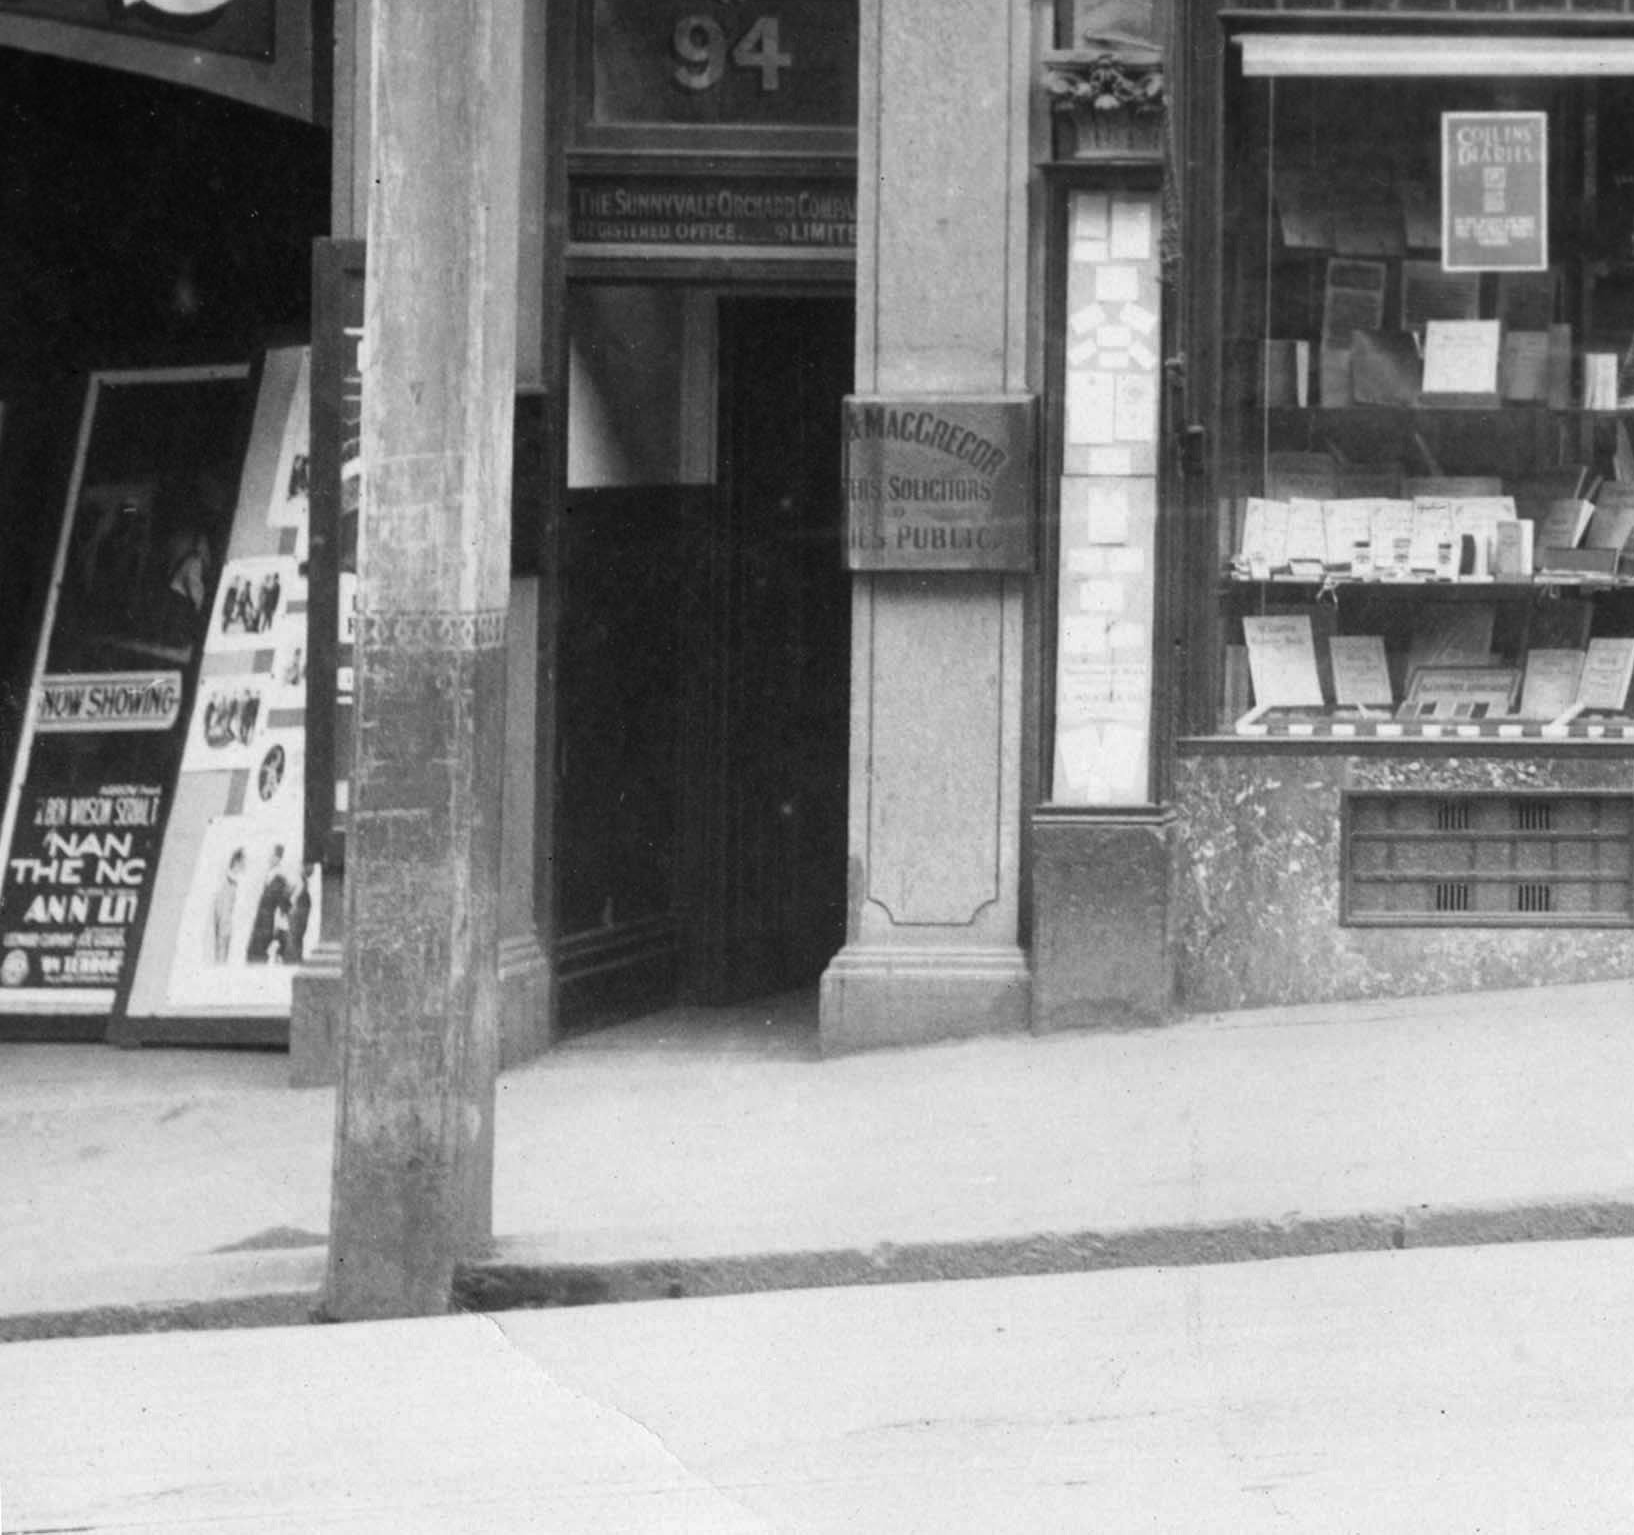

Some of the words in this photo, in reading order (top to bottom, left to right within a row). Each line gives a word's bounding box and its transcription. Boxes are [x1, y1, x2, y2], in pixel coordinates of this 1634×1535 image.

[672, 15, 793, 91] 94
[41, 690, 85, 718] NOW
[87, 686, 176, 717] SHOWING
[11, 858, 85, 885] THE
[24, 894, 88, 924] ANN
